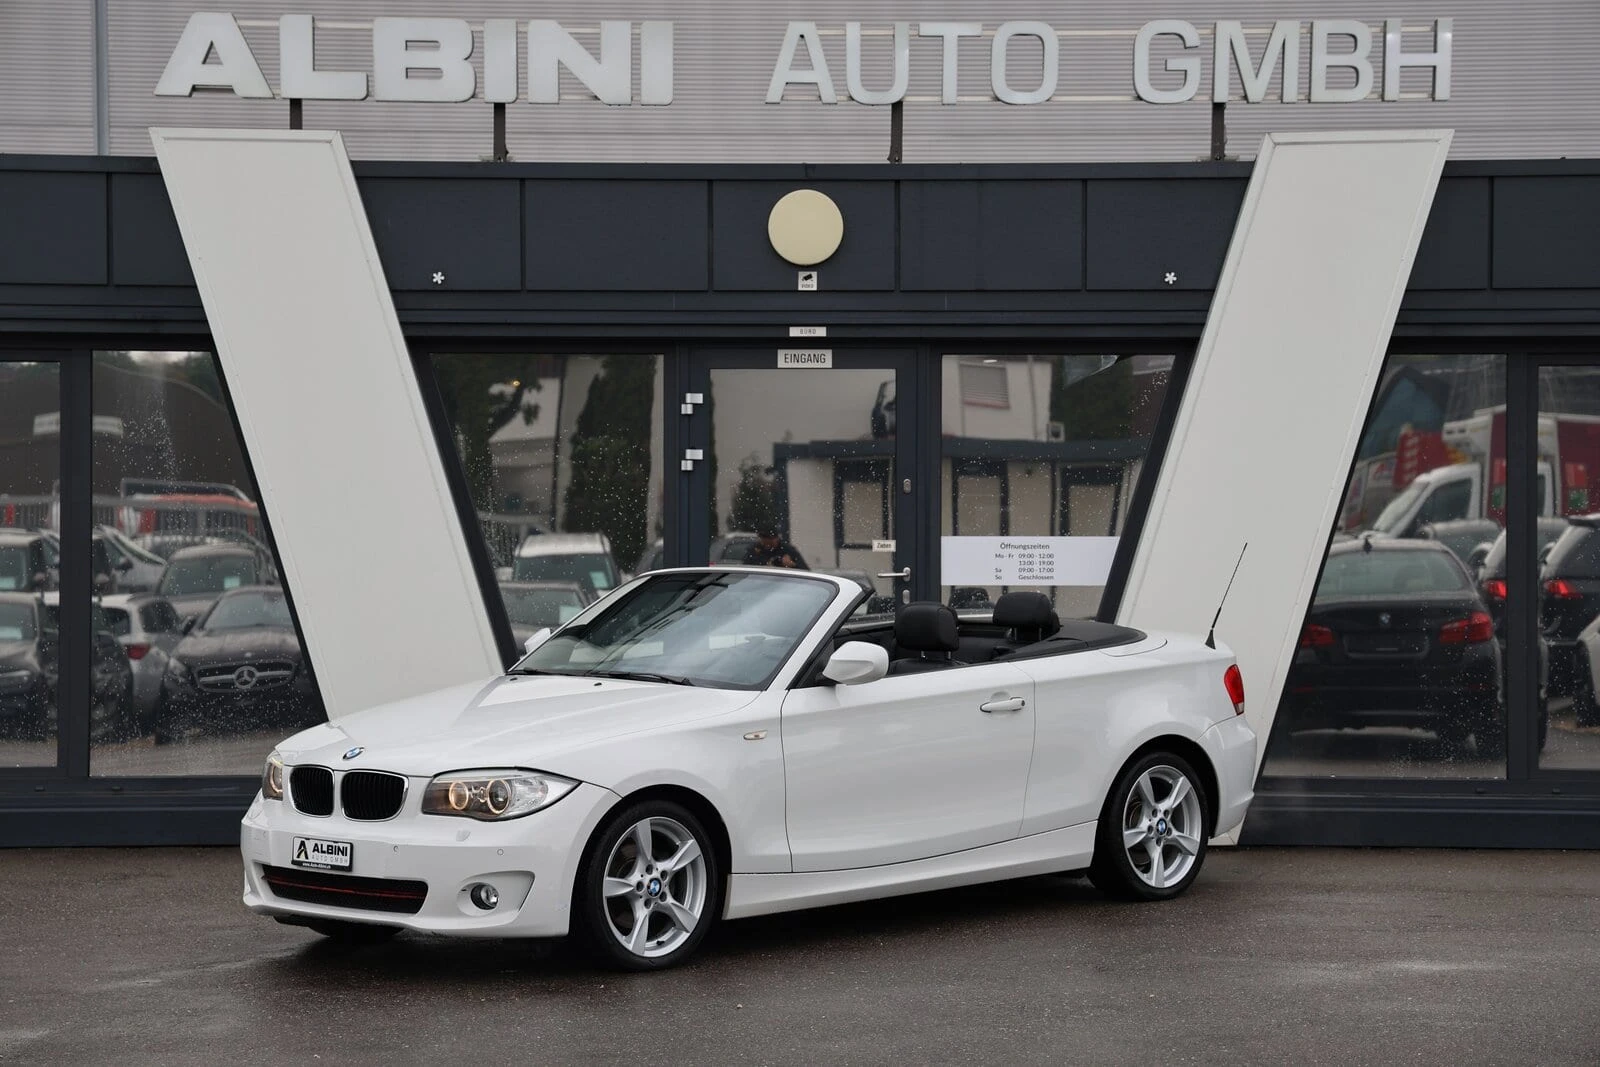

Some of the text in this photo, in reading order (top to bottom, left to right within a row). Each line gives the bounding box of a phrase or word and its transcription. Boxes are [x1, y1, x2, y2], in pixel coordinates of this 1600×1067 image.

[154, 12, 1453, 105] ALBINI AUTO GMBH
[784, 353, 826, 363] EINGANG
[1000, 542, 1050, 551] Öffnungszeiten
[312, 843, 348, 856] ALBINI
